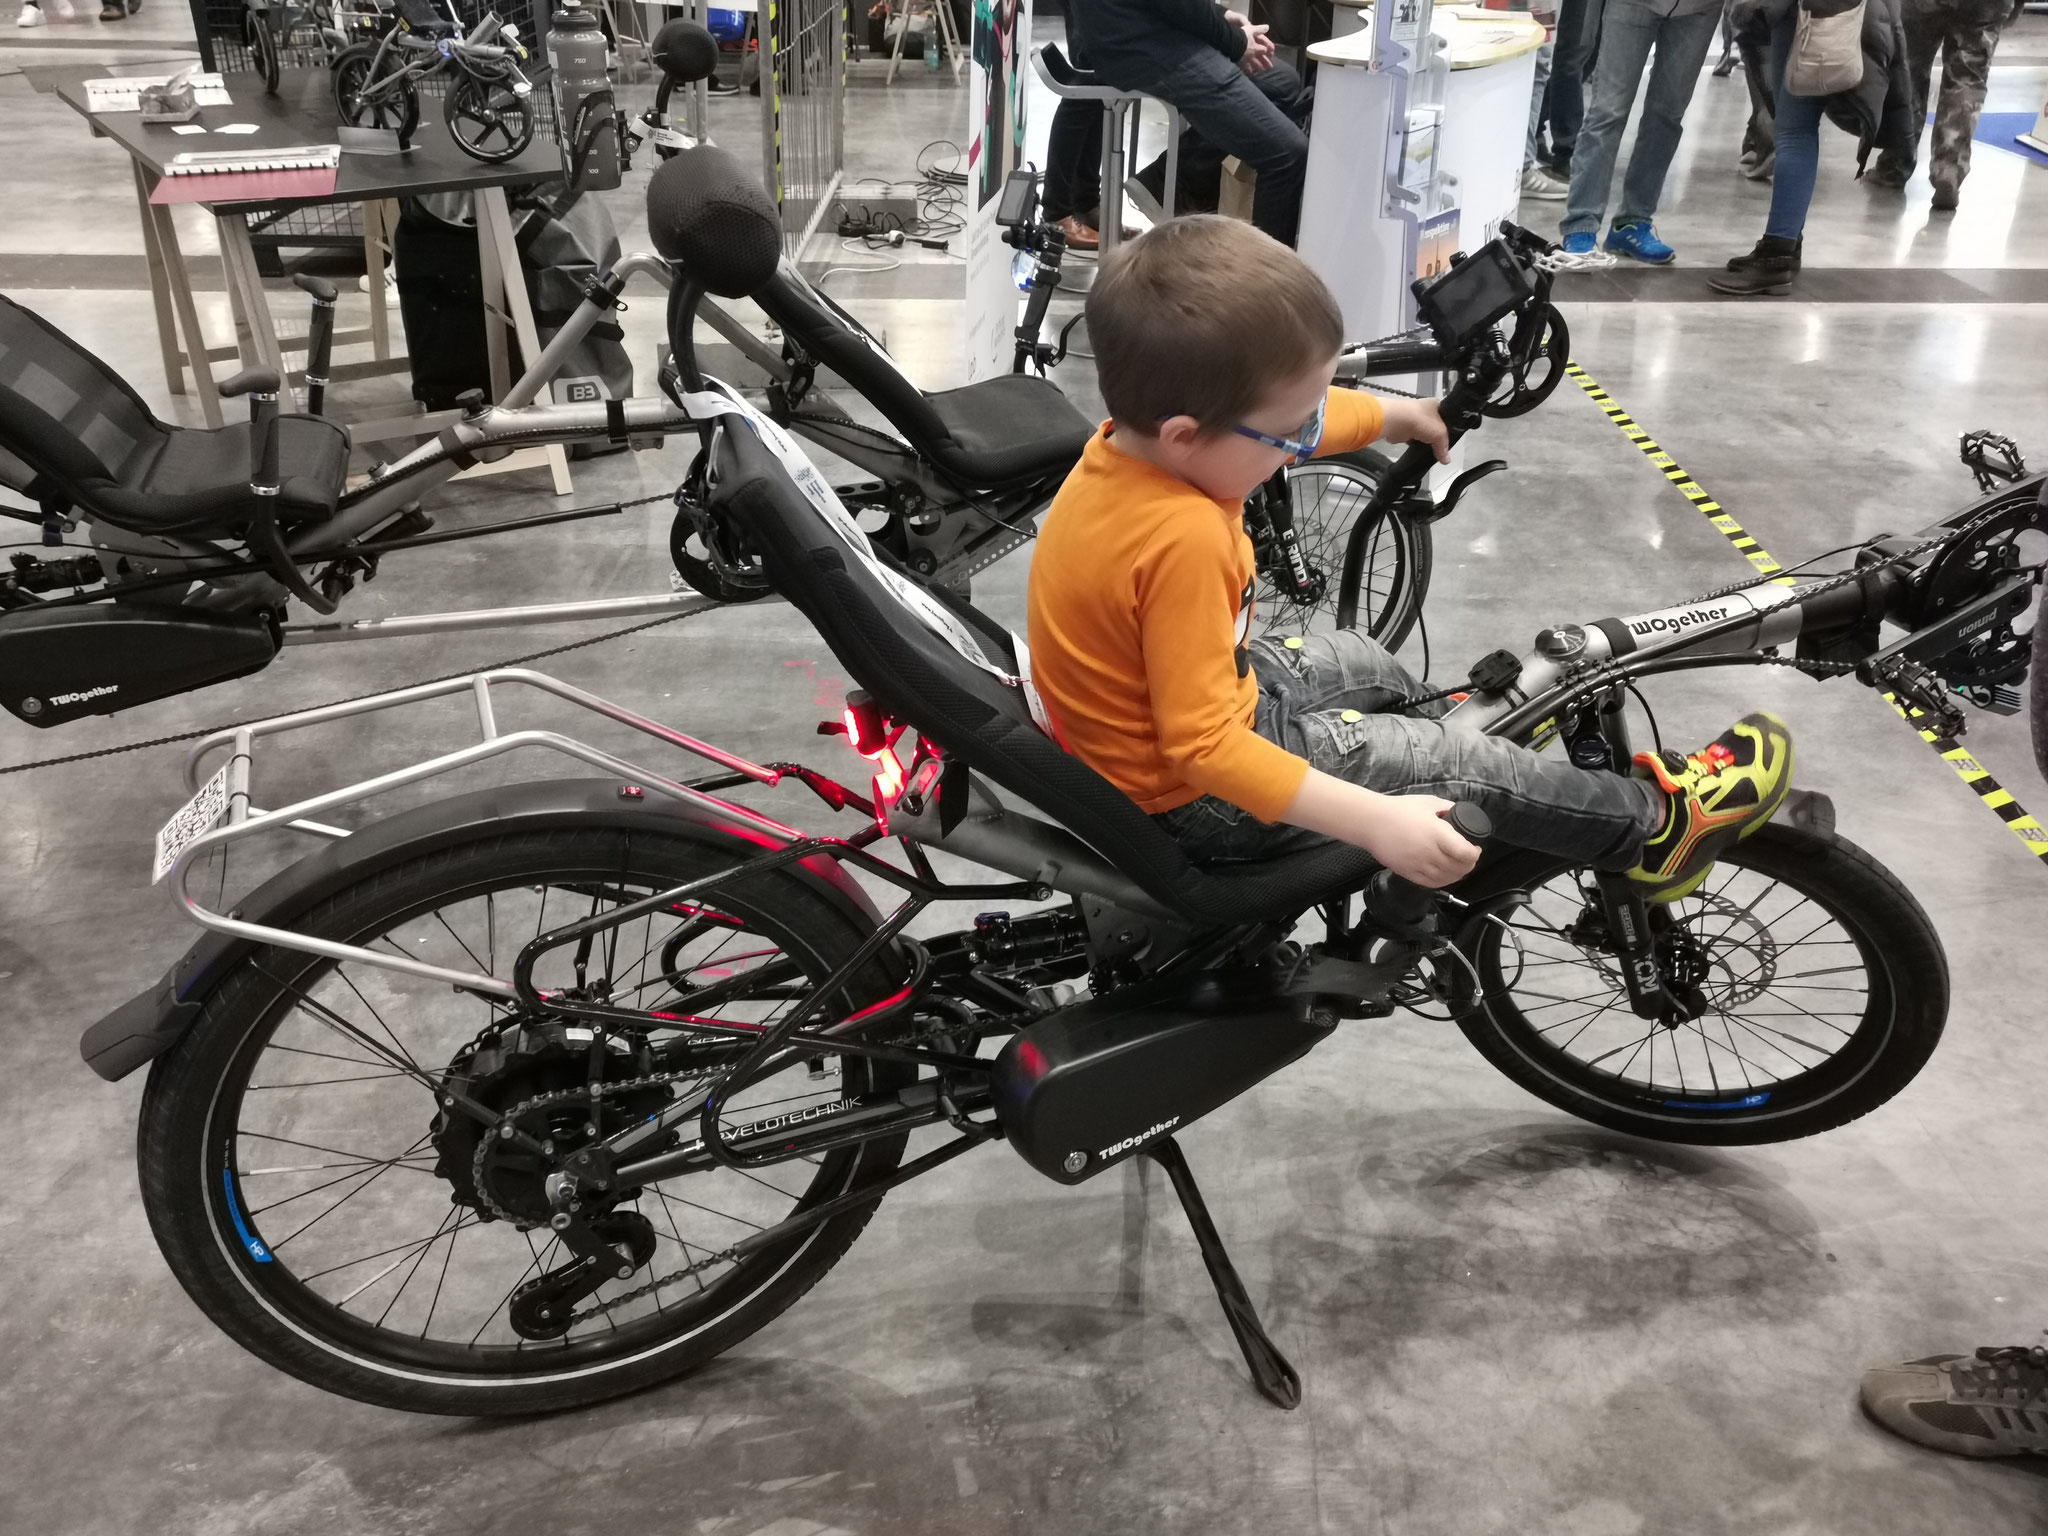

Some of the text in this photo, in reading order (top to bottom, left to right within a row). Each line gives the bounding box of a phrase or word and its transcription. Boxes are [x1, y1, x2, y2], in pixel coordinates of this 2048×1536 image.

[573, 385, 596, 400] B3
[1628, 608, 1728, 635] WOgether
[1958, 607, 1998, 638] pinion
[49, 685, 119, 706] TWOgether
[724, 1095, 862, 1141] VELOTECHNIK
[1099, 1115, 1180, 1160] TWOgether
